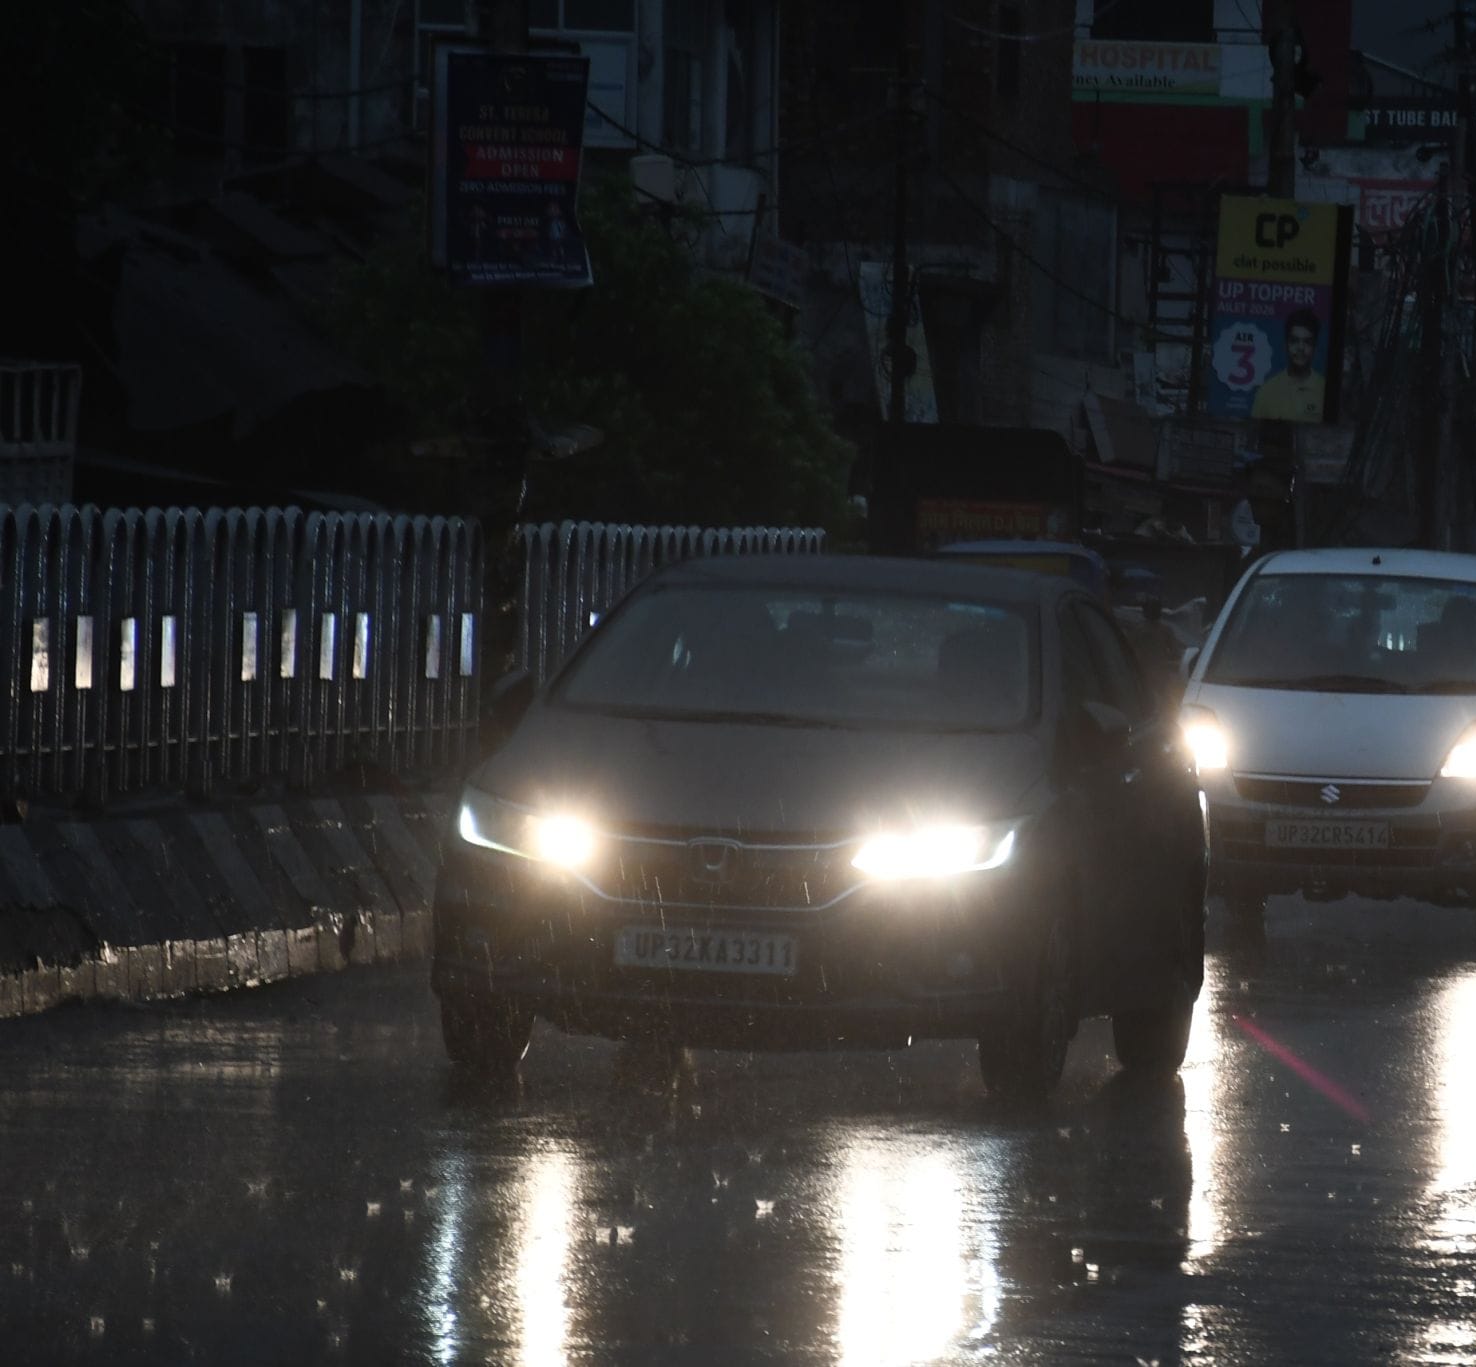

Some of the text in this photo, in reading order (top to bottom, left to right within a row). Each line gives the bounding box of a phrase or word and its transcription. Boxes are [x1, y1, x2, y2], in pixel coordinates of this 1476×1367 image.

[1080, 47, 1217, 71] HOSPITAL
[1107, 74, 1176, 89] Available
[1388, 110, 1425, 127] TUBE
[476, 146, 564, 164] ADMISSION
[501, 163, 540, 178] OPEN
[1255, 213, 1299, 248] CP
[1262, 256, 1317, 274] possible
[1218, 279, 1315, 305] UP TOPPER
[1228, 344, 1255, 385] 3
[1278, 825, 1386, 845] UP32CR5414
[635, 932, 793, 967] UP32KA3311
